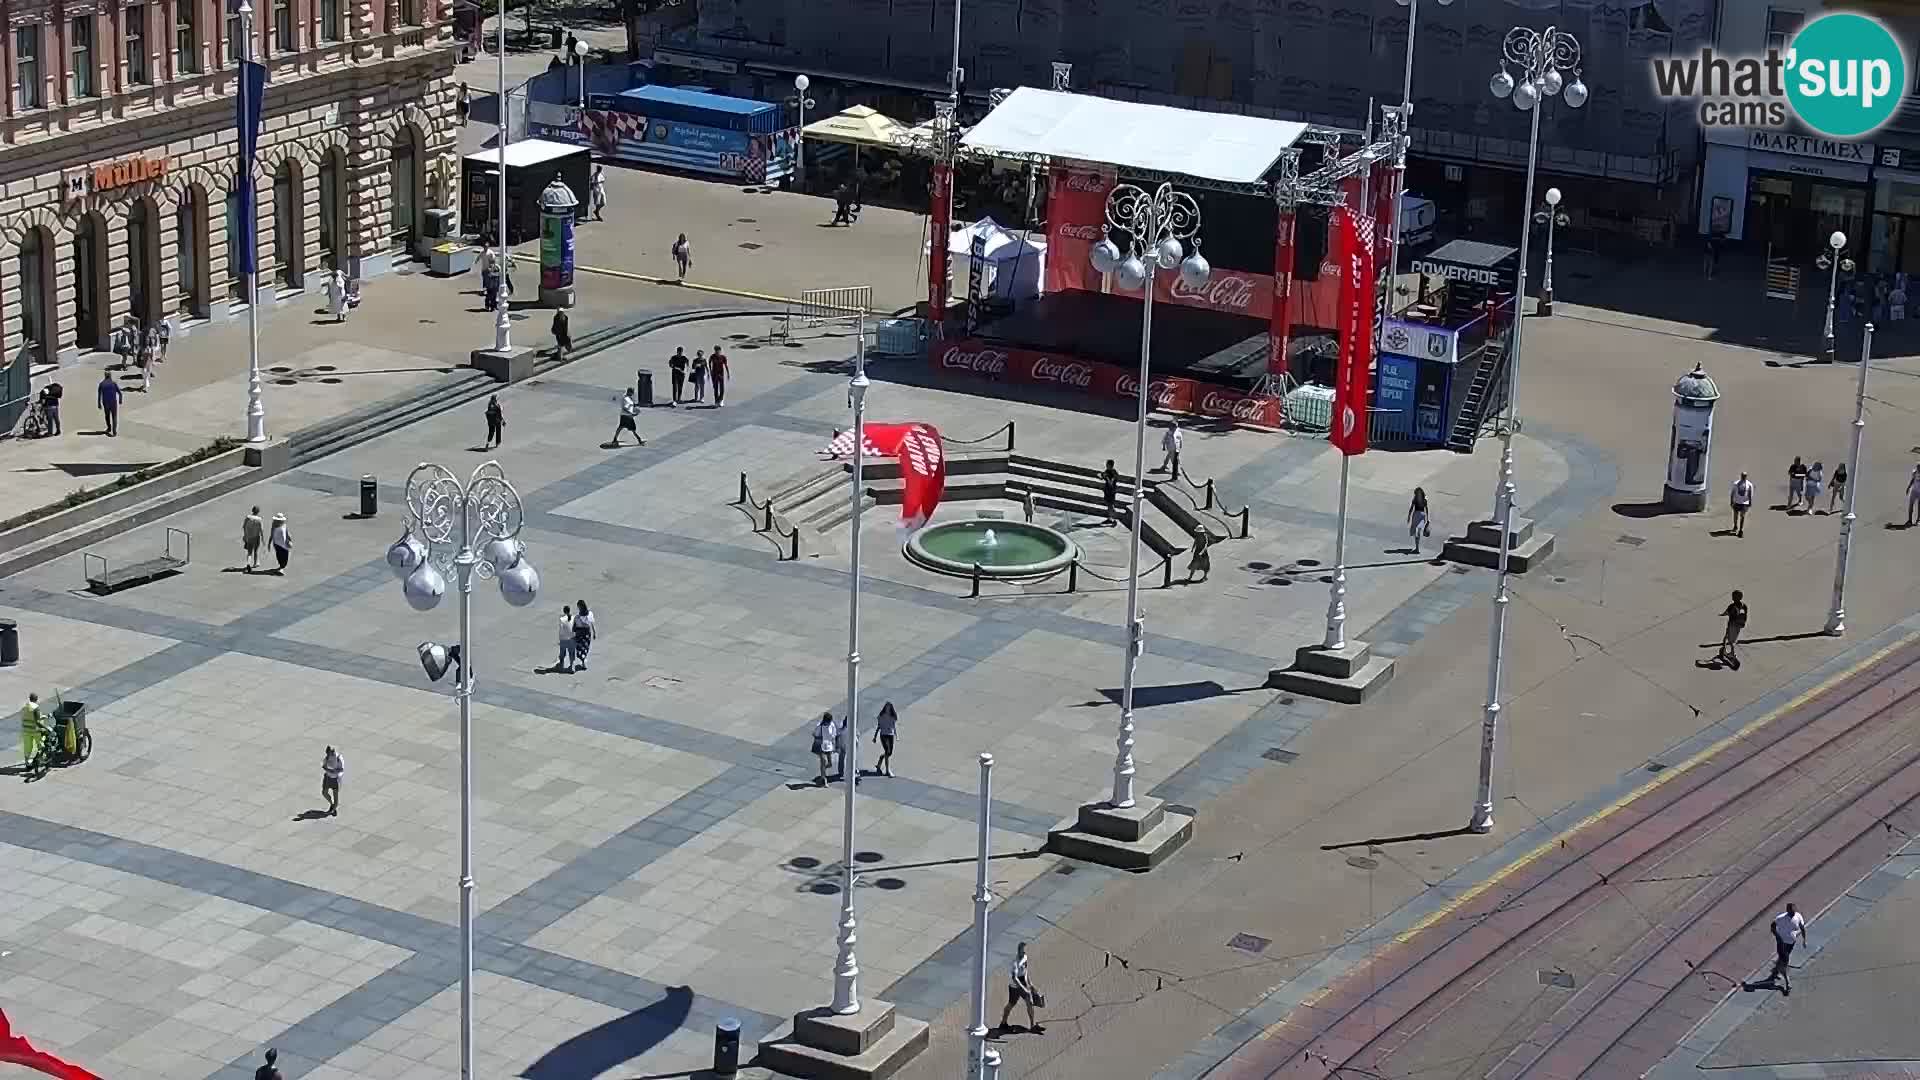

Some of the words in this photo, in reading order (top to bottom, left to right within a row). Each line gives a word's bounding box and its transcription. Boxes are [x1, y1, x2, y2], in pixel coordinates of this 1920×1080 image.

[1753, 132, 1864, 160] MARTIMEX
[95, 157, 167, 190] Müller
[1411, 260, 1499, 285] POWERADE
[943, 346, 1008, 373] Coca-Cola
[1032, 357, 1094, 386] Coca-Cola
[1202, 391, 1267, 421] Coca-Cola
